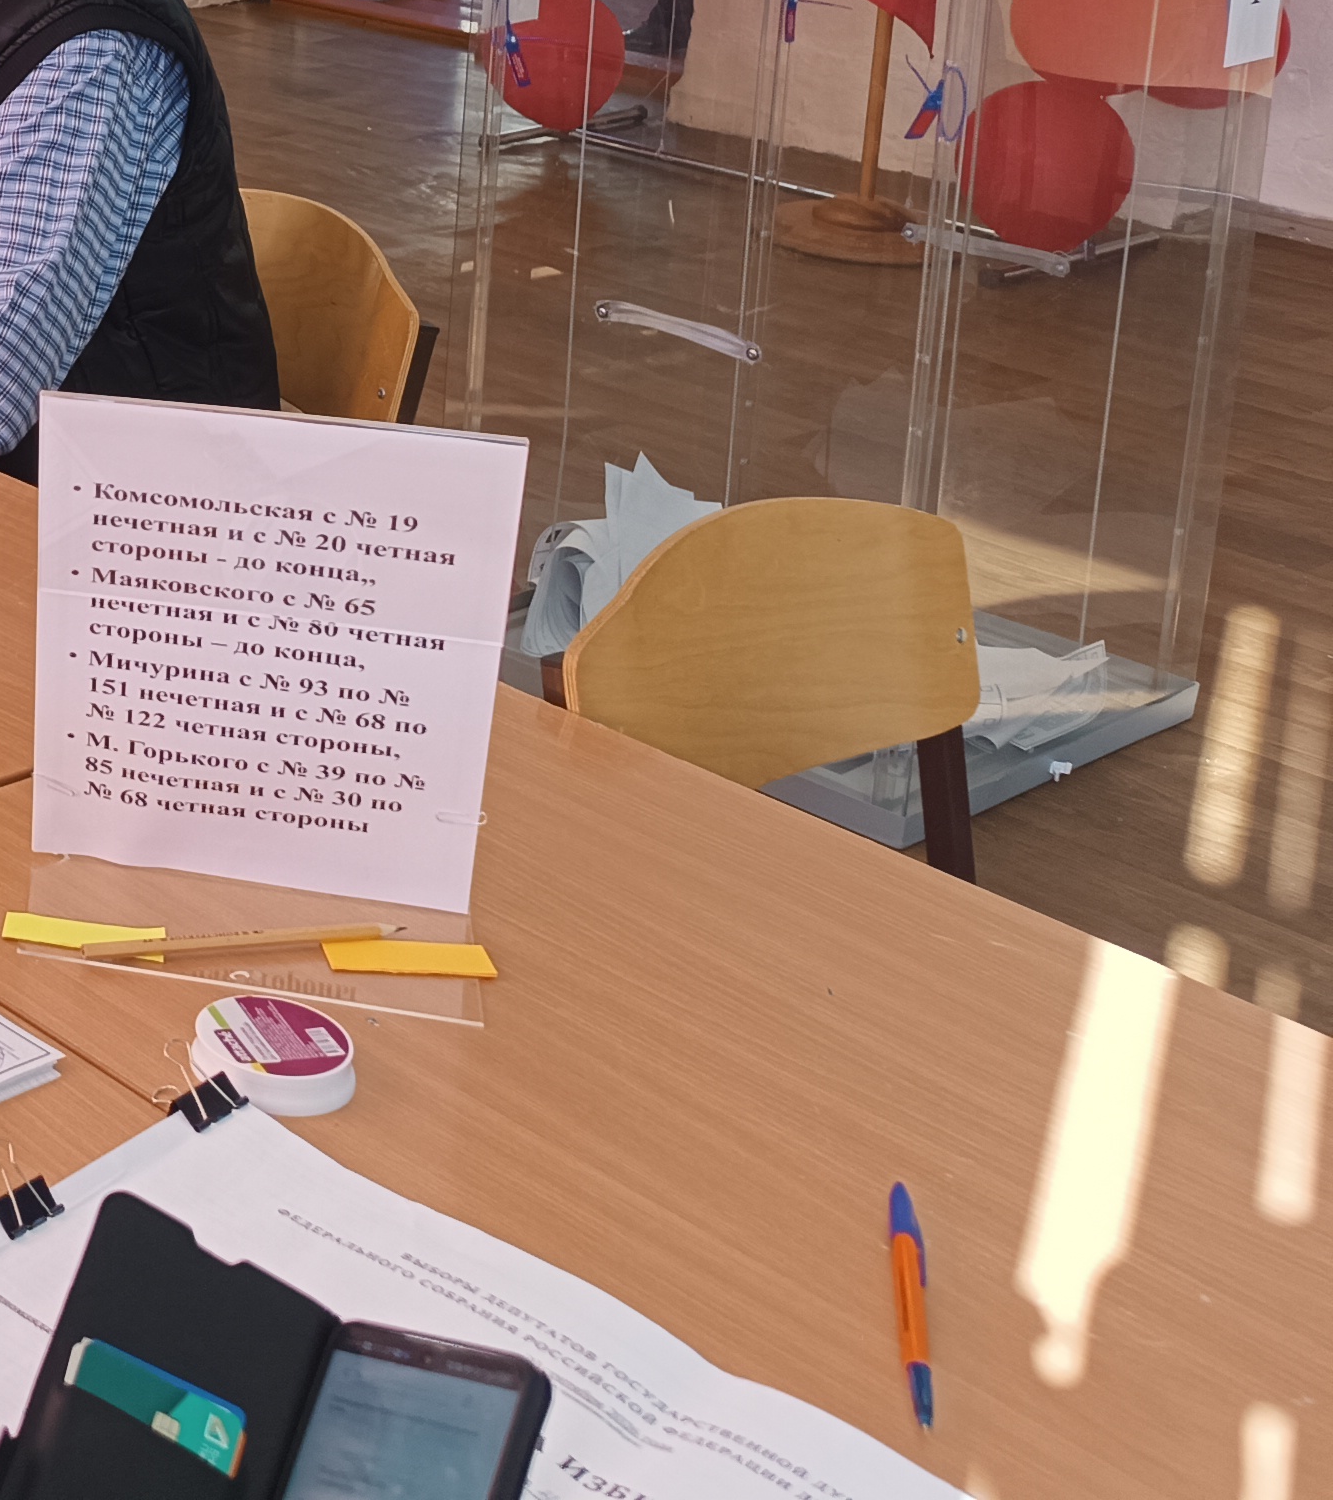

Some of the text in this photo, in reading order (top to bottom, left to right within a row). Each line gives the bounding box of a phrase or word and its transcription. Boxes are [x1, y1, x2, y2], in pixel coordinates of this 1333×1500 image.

[93, 482, 419, 533] Комсомольская № 19
[91, 538, 377, 587] стороны до конца,,
[92, 512, 456, 566] нечетная № 20 четная
[91, 567, 377, 617] Маяковского № 65
[89, 621, 366, 672] стороны до конца,
[90, 597, 447, 652] нечетная № 80 четная
[87, 676, 428, 737] 151 нечетная № 68 по
[88, 650, 411, 707] Мичурина № 93 по №
[86, 702, 401, 761] № 122 четная стороны,
[85, 756, 403, 815] 85 нечетная № 30 по
[86, 731, 427, 791] М. Горького № 39 по №
[83, 780, 371, 835] № 68 четная стороны
[277, 1207, 415, 1280] ФЕДЕРАЛЬНОГО
[418, 1277, 519, 1336] СОБРАНИЯ
[399, 1252, 480, 1294] ВЫБОРЫ
[482, 1293, 598, 1362] ДЕПУТАТОВ
